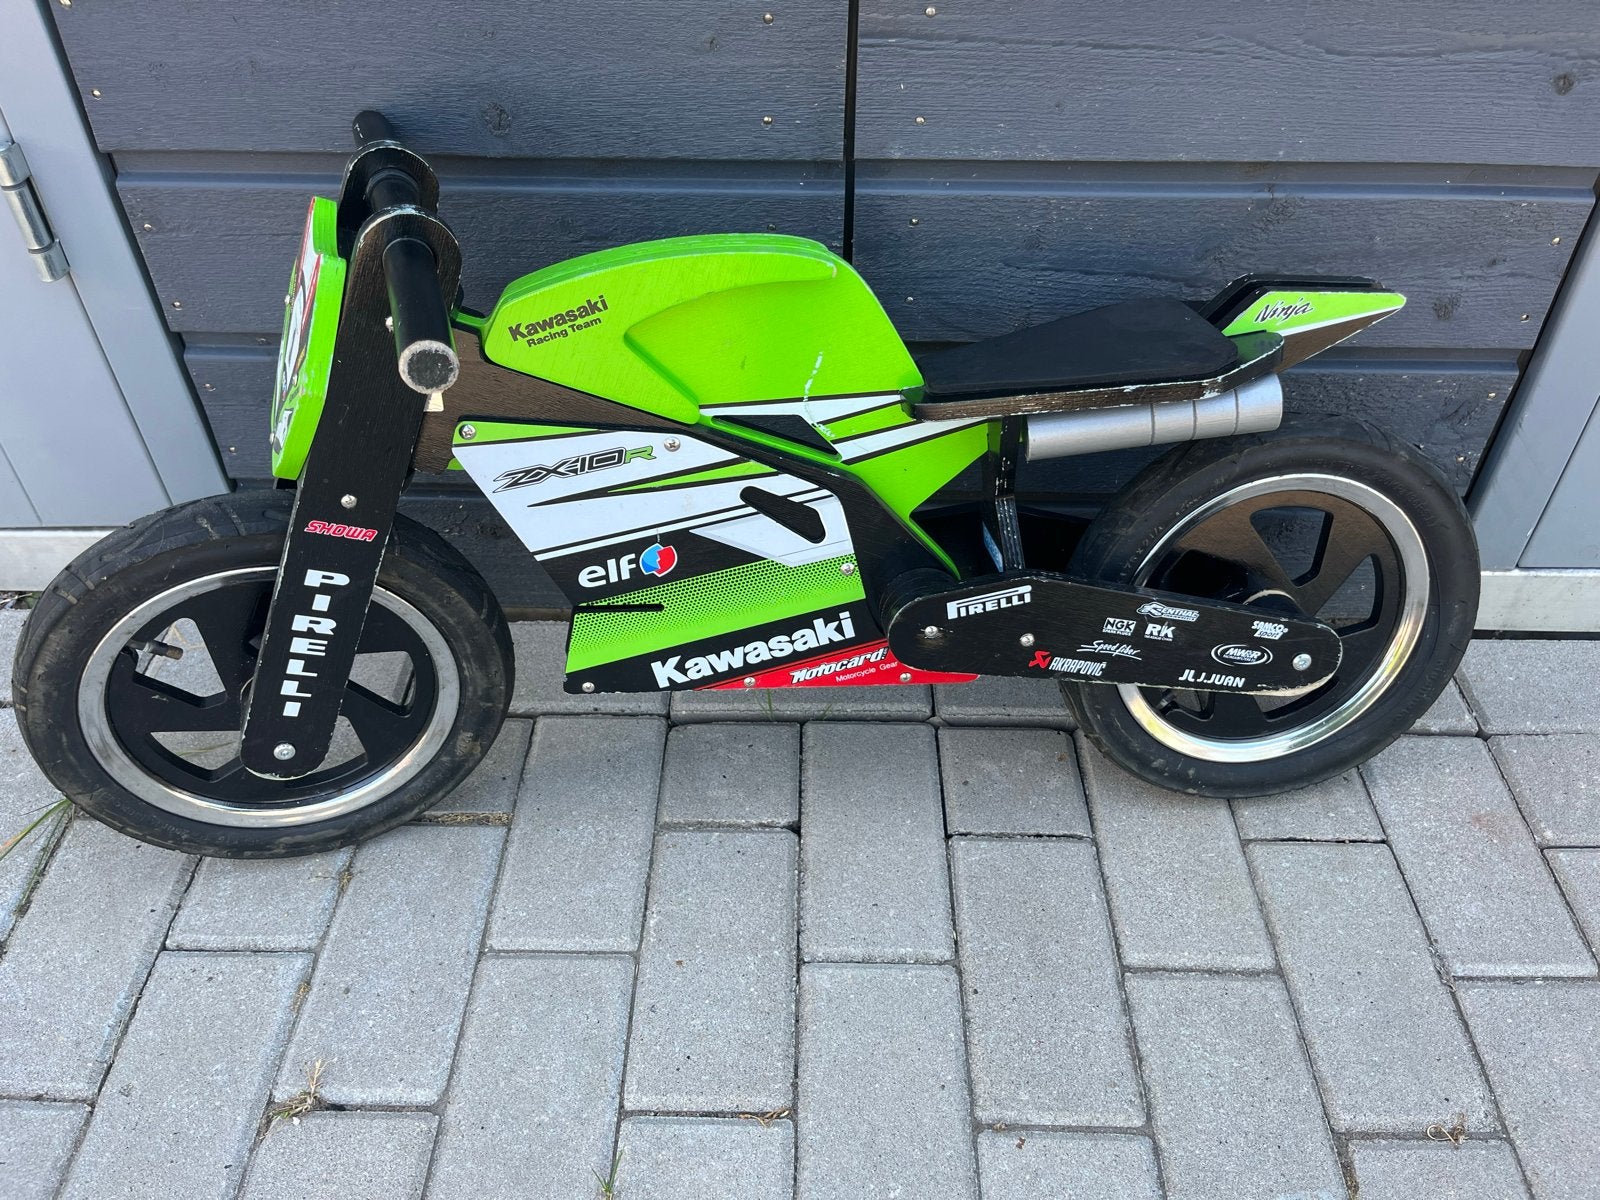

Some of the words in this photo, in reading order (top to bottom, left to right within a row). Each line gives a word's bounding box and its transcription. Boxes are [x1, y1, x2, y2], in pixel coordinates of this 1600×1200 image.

[508, 294, 609, 341] Kawasaki
[1254, 297, 1314, 326] Ninja
[526, 328, 569, 348] Racing
[568, 317, 602, 333] Team
[304, 519, 378, 541] SHOWA
[577, 553, 636, 588] elf
[946, 584, 1032, 619] PIRELLI
[1103, 618, 1136, 633] NGK
[1145, 623, 1176, 638] RK
[1251, 620, 1285, 633] SAMCO
[280, 569, 350, 717] PIRELLI
[650, 610, 856, 689] Kawasaki
[835, 667, 877, 683] Motorcycle
[878, 661, 898, 671] Gear
[1196, 672, 1245, 688] J.JUAN
